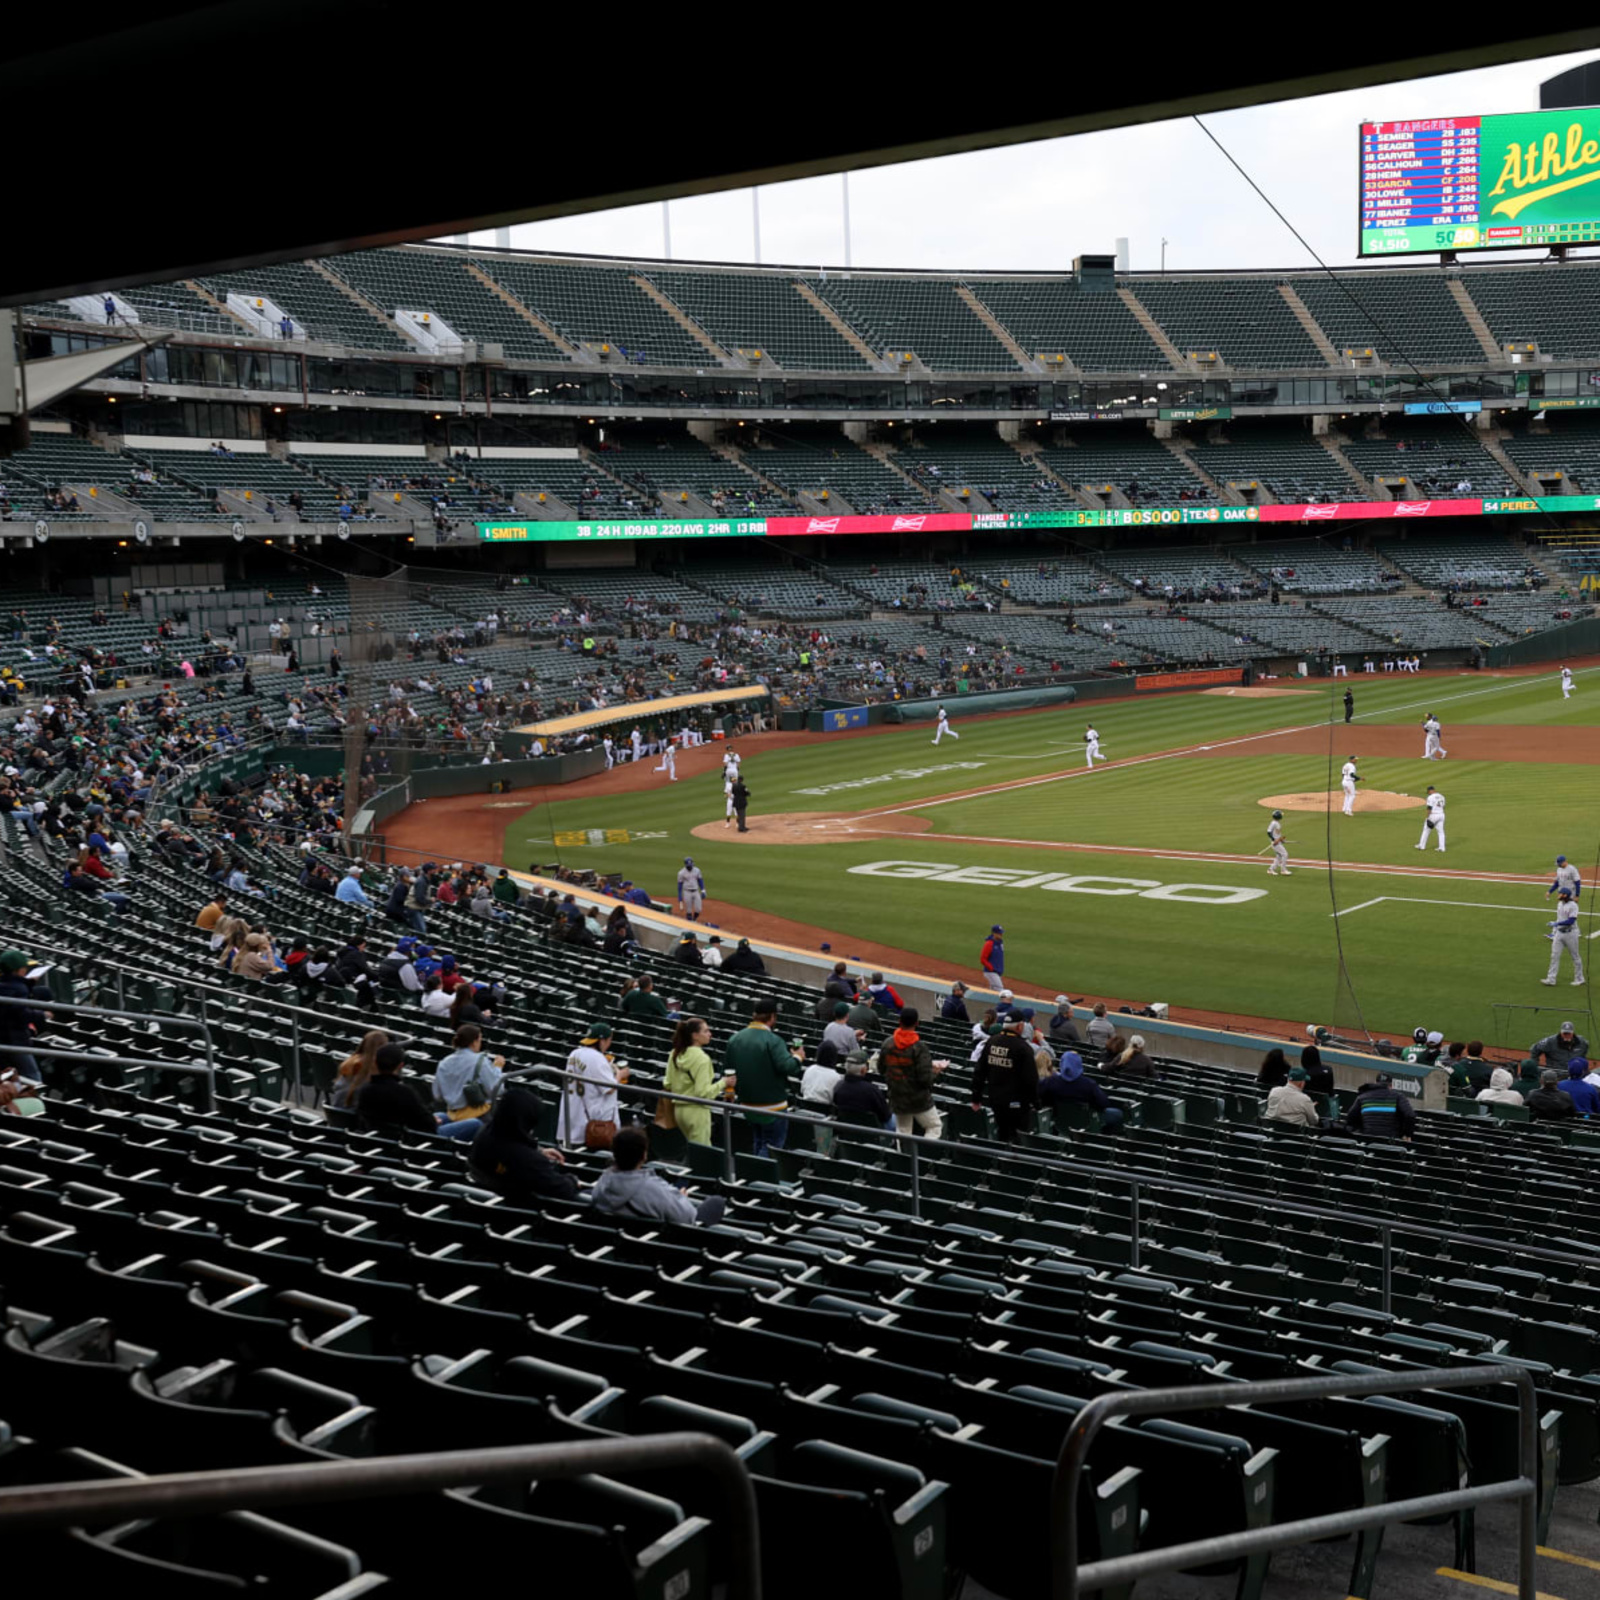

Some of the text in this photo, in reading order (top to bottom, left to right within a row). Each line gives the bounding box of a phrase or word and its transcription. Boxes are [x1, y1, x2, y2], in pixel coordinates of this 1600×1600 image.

[1394, 119, 1455, 133] RANGERS
[1377, 132, 1414, 141] SEMIEN
[1377, 142, 1414, 151] SEAGER
[1442, 139, 1454, 147] SS
[1377, 151, 1415, 160] GARVER
[1441, 148, 1455, 156] DH
[1377, 160, 1422, 169] CALHOUN
[1377, 171, 1402, 179] HEIM
[1377, 180, 1412, 188] GARCIA
[1377, 189, 1405, 197] LOWE
[1377, 198, 1412, 206] MILLER
[1377, 209, 1411, 217] IBANEZ
[1376, 219, 1407, 227] PEREZ
[1436, 231, 1455, 243] 50
[1369, 239, 1410, 251] $1,510
[1484, 502, 1498, 511] 54
[1501, 501, 1538, 511] PEREZ
[1078, 513, 1085, 524] 3
[1189, 510, 1208, 519] TEX
[1223, 510, 1246, 519] OAK
[492, 528, 527, 539] SMITH
[577, 526, 591, 536] 3B
[597, 525, 609, 536] 24
[612, 525, 621, 536] H
[683, 523, 704, 535] AVG
[847, 860, 1268, 904] GEICO
[991, 1045, 1009, 1057] GUEST
